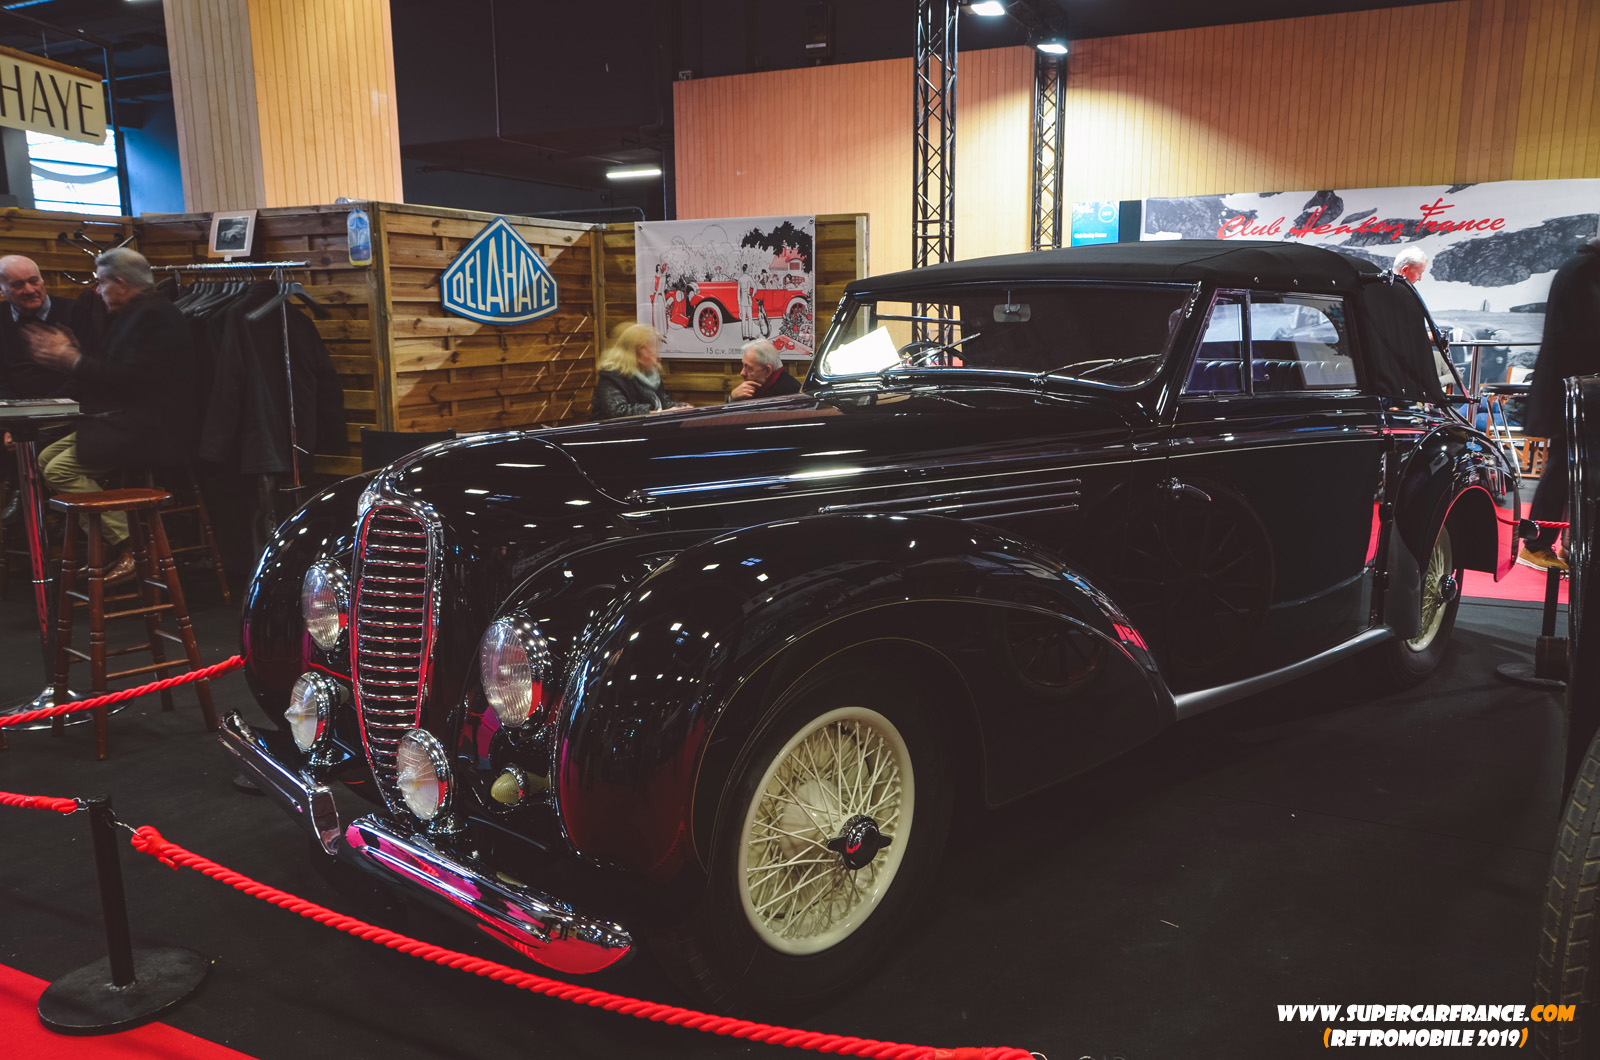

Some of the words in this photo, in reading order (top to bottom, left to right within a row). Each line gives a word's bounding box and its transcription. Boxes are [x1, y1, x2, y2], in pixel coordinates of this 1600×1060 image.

[1217, 215, 1286, 240] Club
[1289, 205, 1403, 241] Healey
[1415, 198, 1506, 233] France
[452, 229, 550, 313] DELAHAYE
